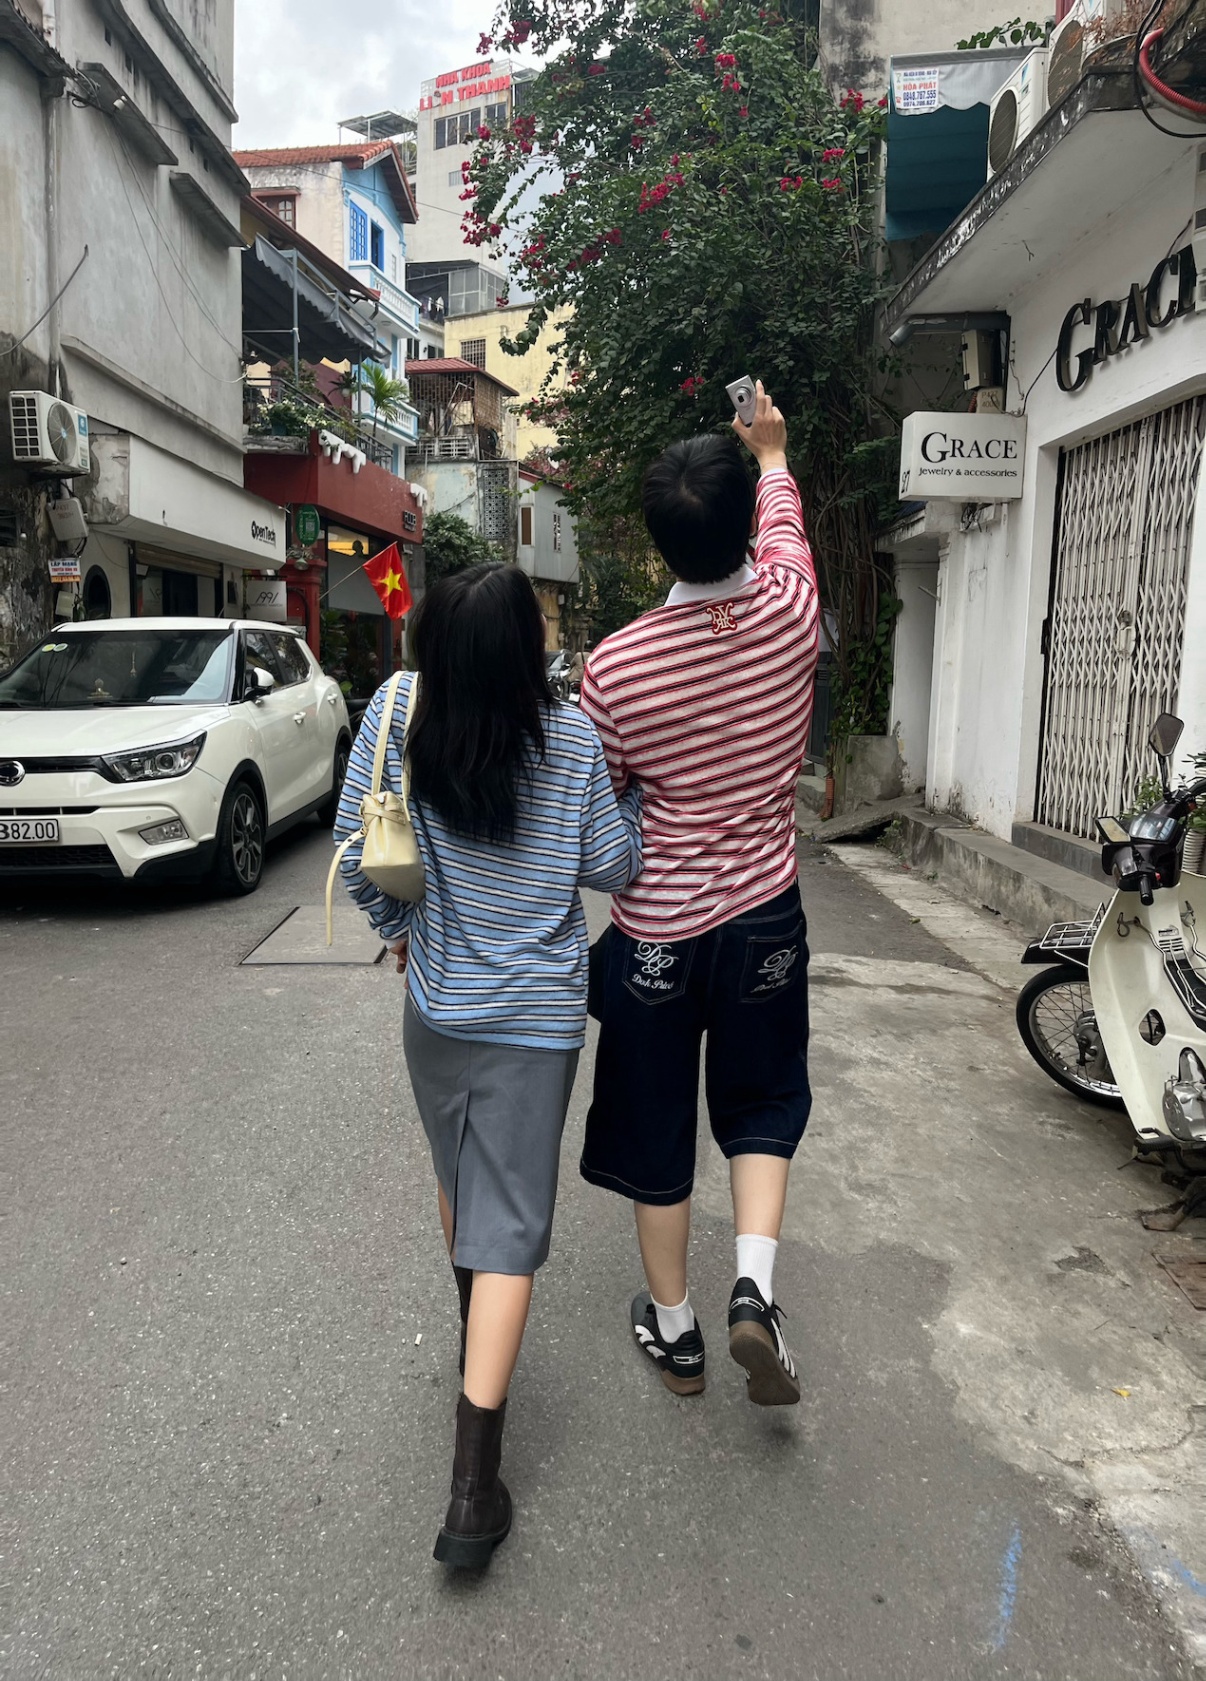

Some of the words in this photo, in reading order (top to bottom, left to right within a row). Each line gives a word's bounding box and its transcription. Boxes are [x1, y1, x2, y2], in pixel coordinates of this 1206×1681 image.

[461, 62, 491, 81] KHOA
[457, 75, 511, 101] THANH
[921, 431, 1018, 464] GRACE
[955, 468, 962, 476] &
[964, 467, 1018, 478] accessories
